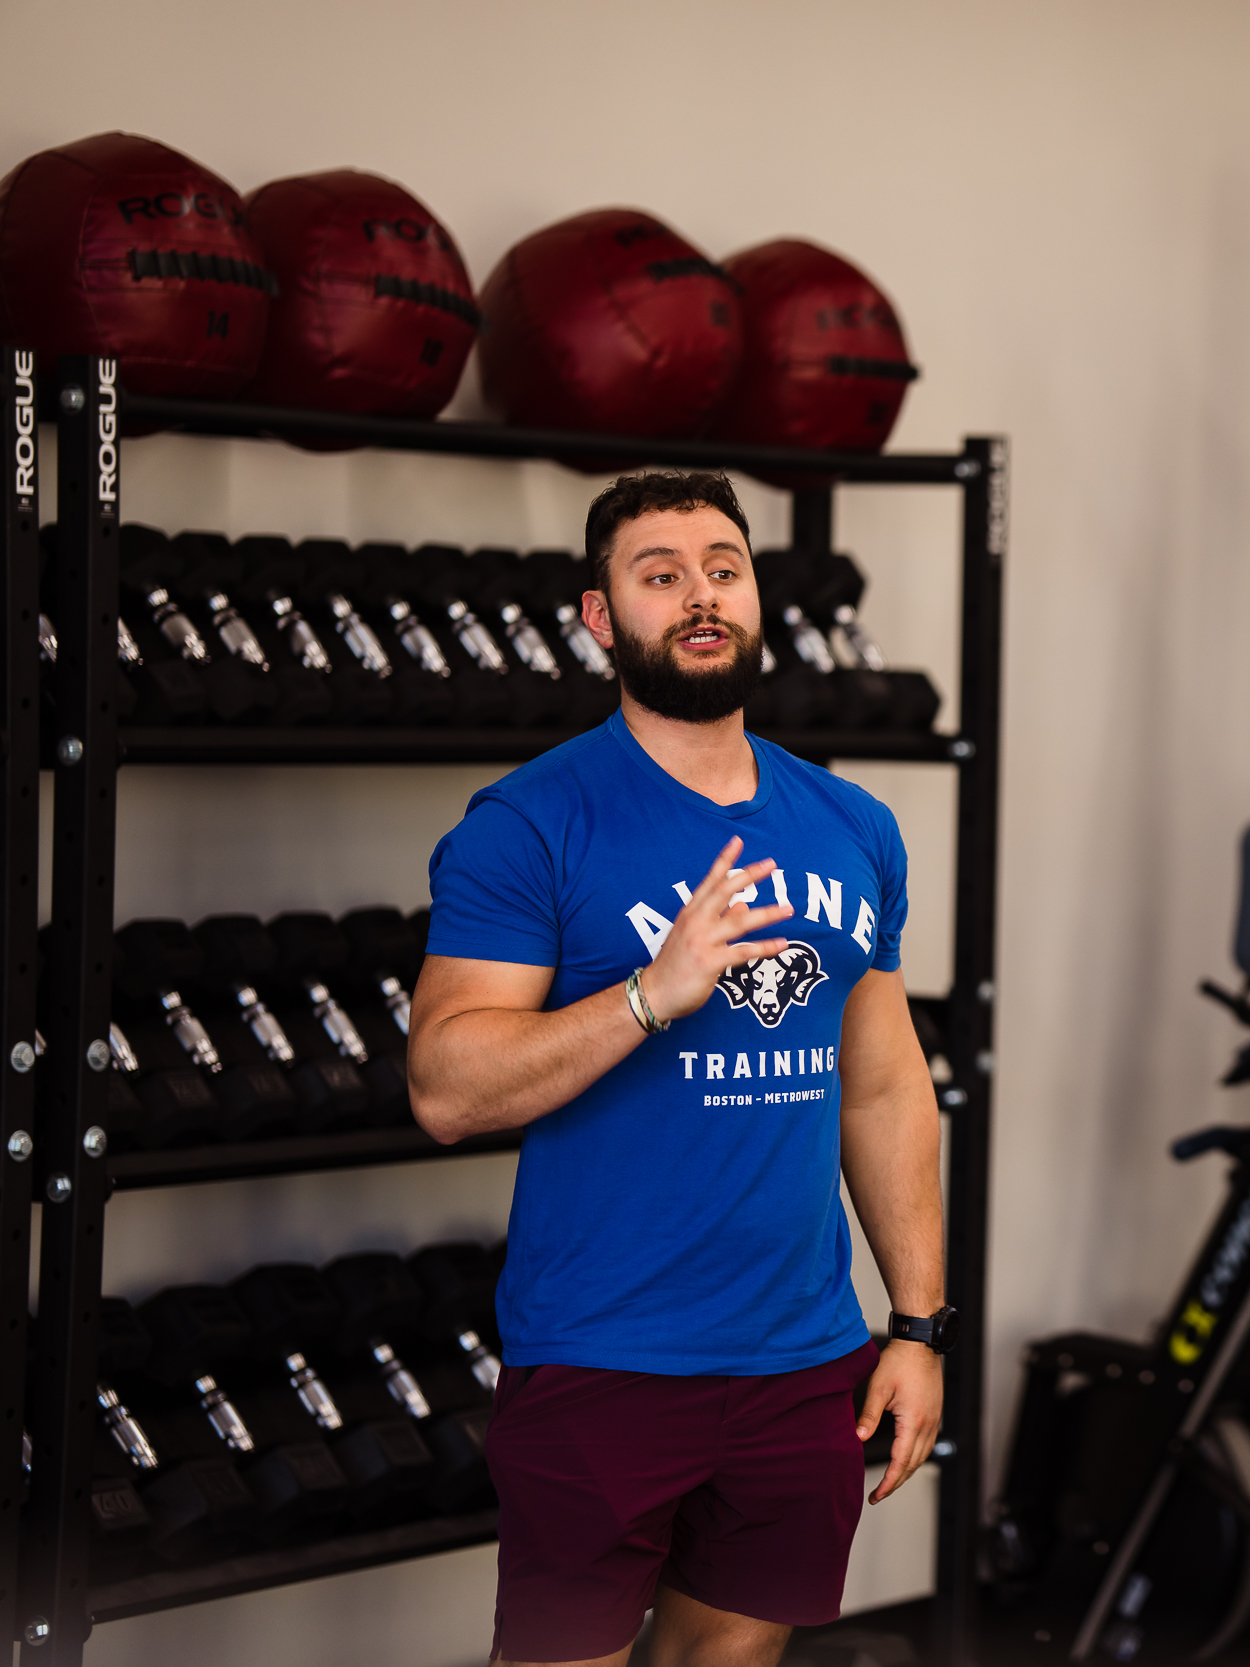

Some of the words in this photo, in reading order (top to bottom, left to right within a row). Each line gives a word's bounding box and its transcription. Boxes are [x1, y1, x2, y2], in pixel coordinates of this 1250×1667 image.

[15, 350, 35, 496] ROGUE
[98, 358, 118, 502] ROGUE
[679, 1046, 834, 1080] TRAINING
[704, 1094, 753, 1106] BOSTON
[764, 1088, 825, 1104] METROWEST
